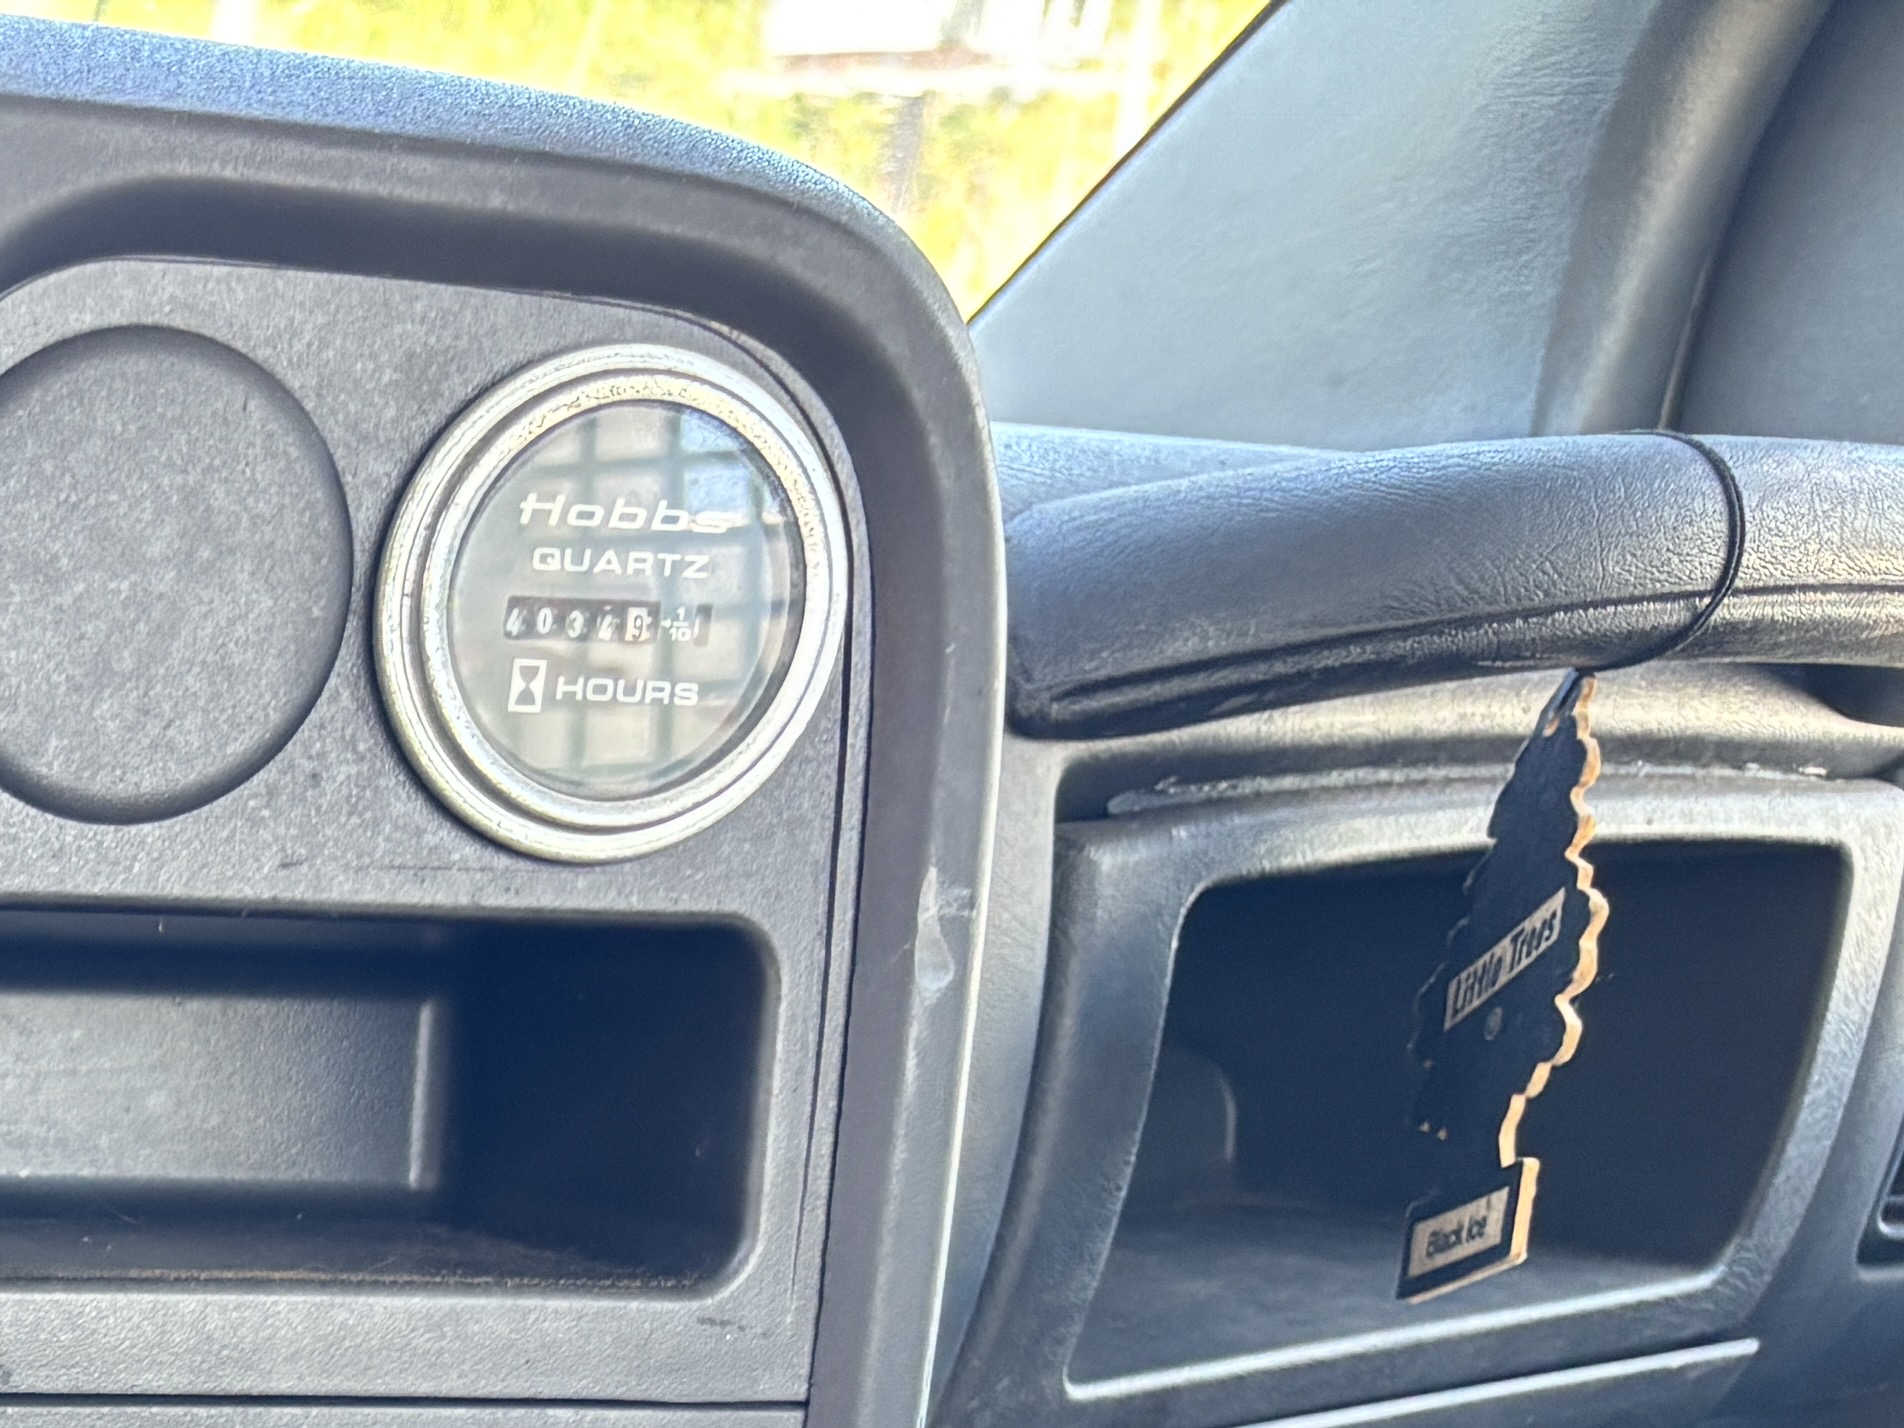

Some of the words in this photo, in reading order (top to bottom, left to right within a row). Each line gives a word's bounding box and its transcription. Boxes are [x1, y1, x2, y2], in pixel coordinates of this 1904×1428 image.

[518, 491, 732, 534] Hobbs
[532, 546, 710, 579] QUARTZ
[555, 674, 700, 706] HOURS
